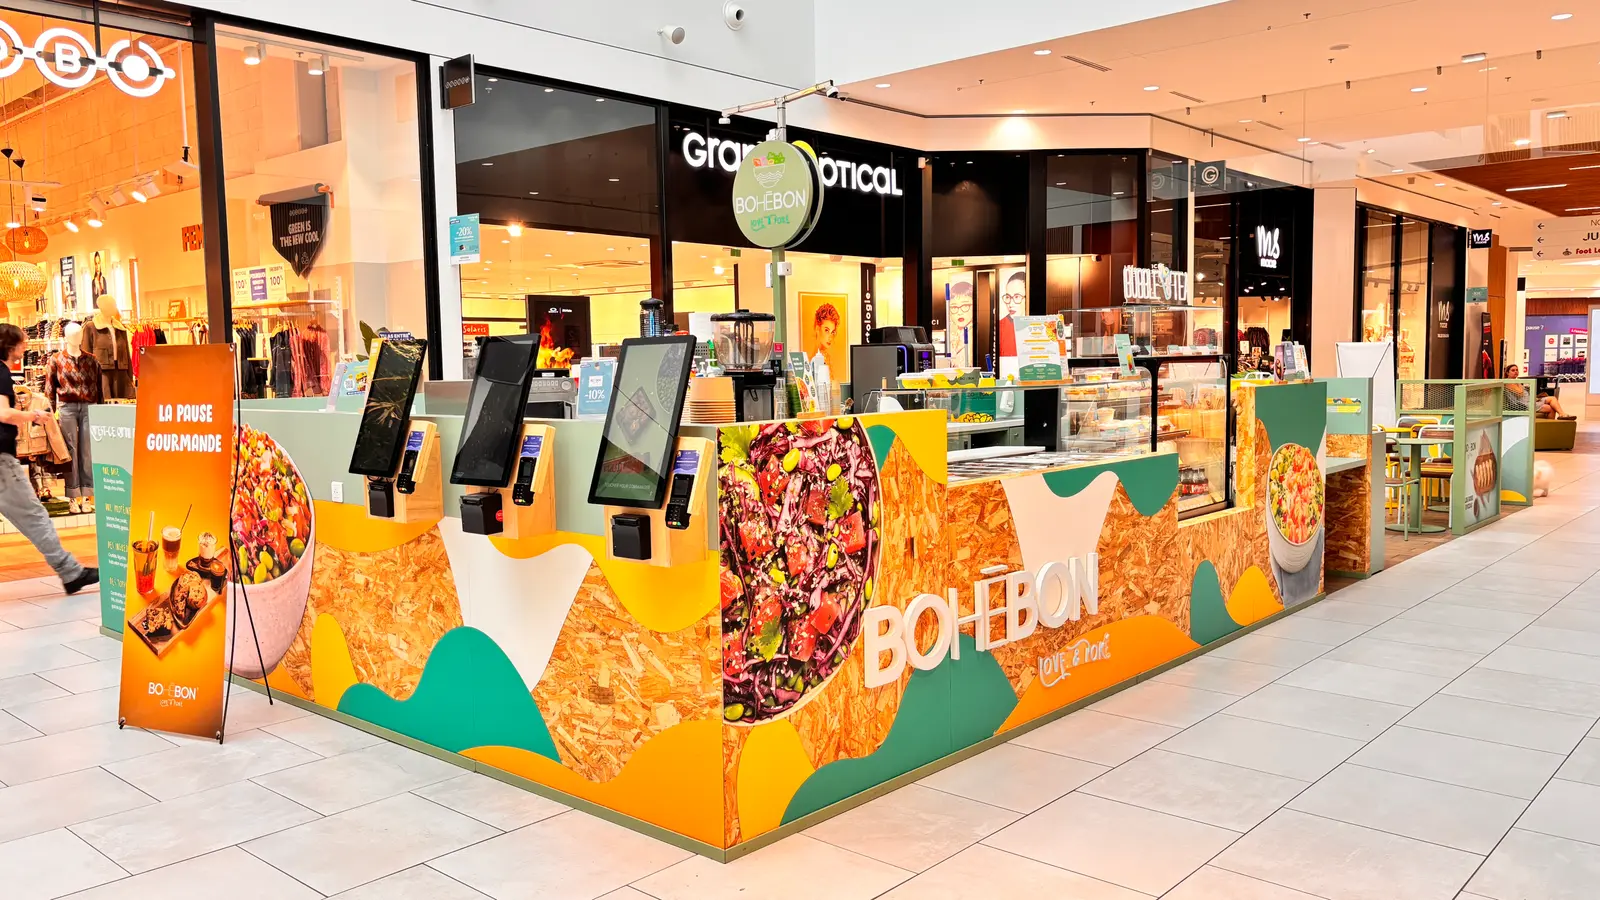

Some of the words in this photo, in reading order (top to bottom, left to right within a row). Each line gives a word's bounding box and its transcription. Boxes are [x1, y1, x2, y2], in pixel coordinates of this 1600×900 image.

[288, 222, 305, 234] GREEN
[305, 220, 311, 231] IS
[280, 236, 292, 248] THE
[304, 231, 319, 243] COOL
[584, 389, 606, 400] -10%
[158, 404, 173, 422] LA
[176, 403, 213, 423] PAUSE
[146, 433, 222, 453] GOURMANDE
[1038, 652, 1071, 687] LOVE
